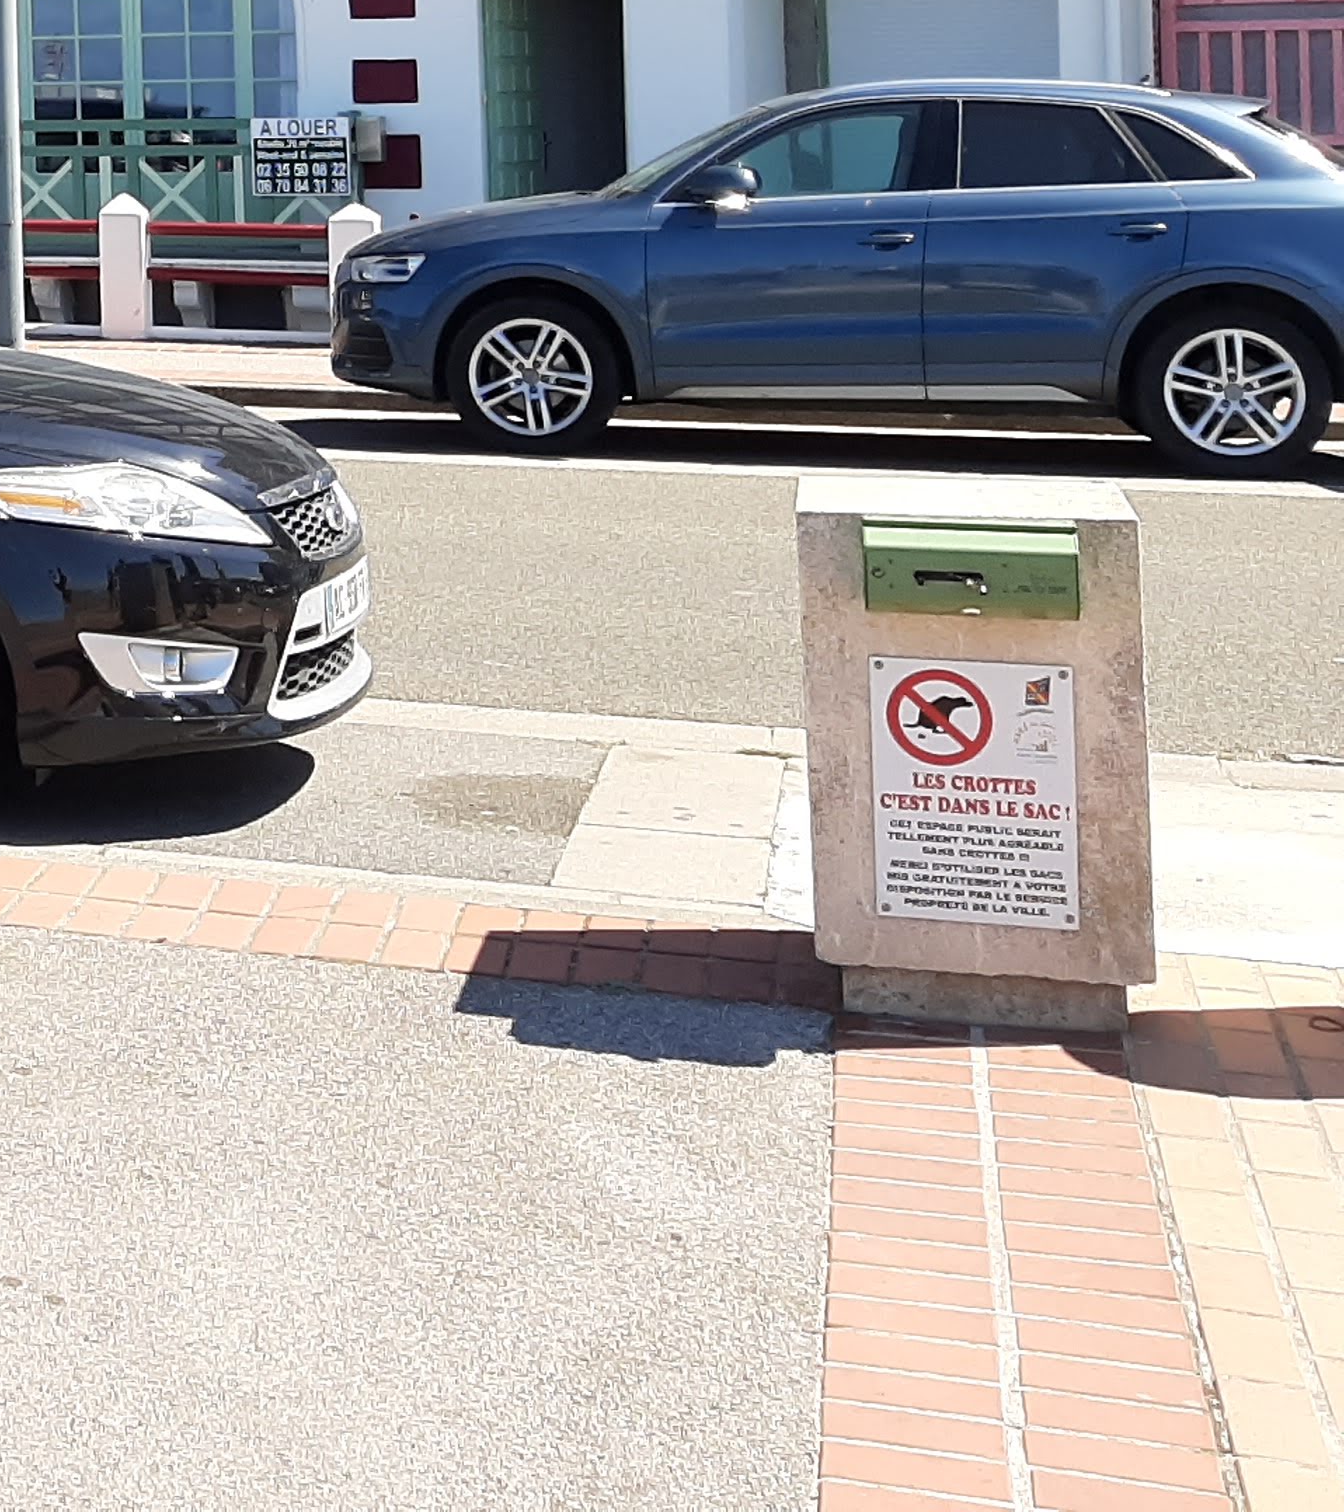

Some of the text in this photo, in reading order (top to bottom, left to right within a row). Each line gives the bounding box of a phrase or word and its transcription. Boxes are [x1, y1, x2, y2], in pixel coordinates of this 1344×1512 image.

[260, 119, 337, 136] A LOUER
[256, 163, 272, 177] 02
[275, 179, 290, 193] 70
[912, 772, 1037, 795] LES CROTTES
[880, 793, 932, 812] C'EST
[938, 796, 991, 816] DANS
[996, 799, 1019, 818] LE
[1023, 802, 1061, 822] SAC
